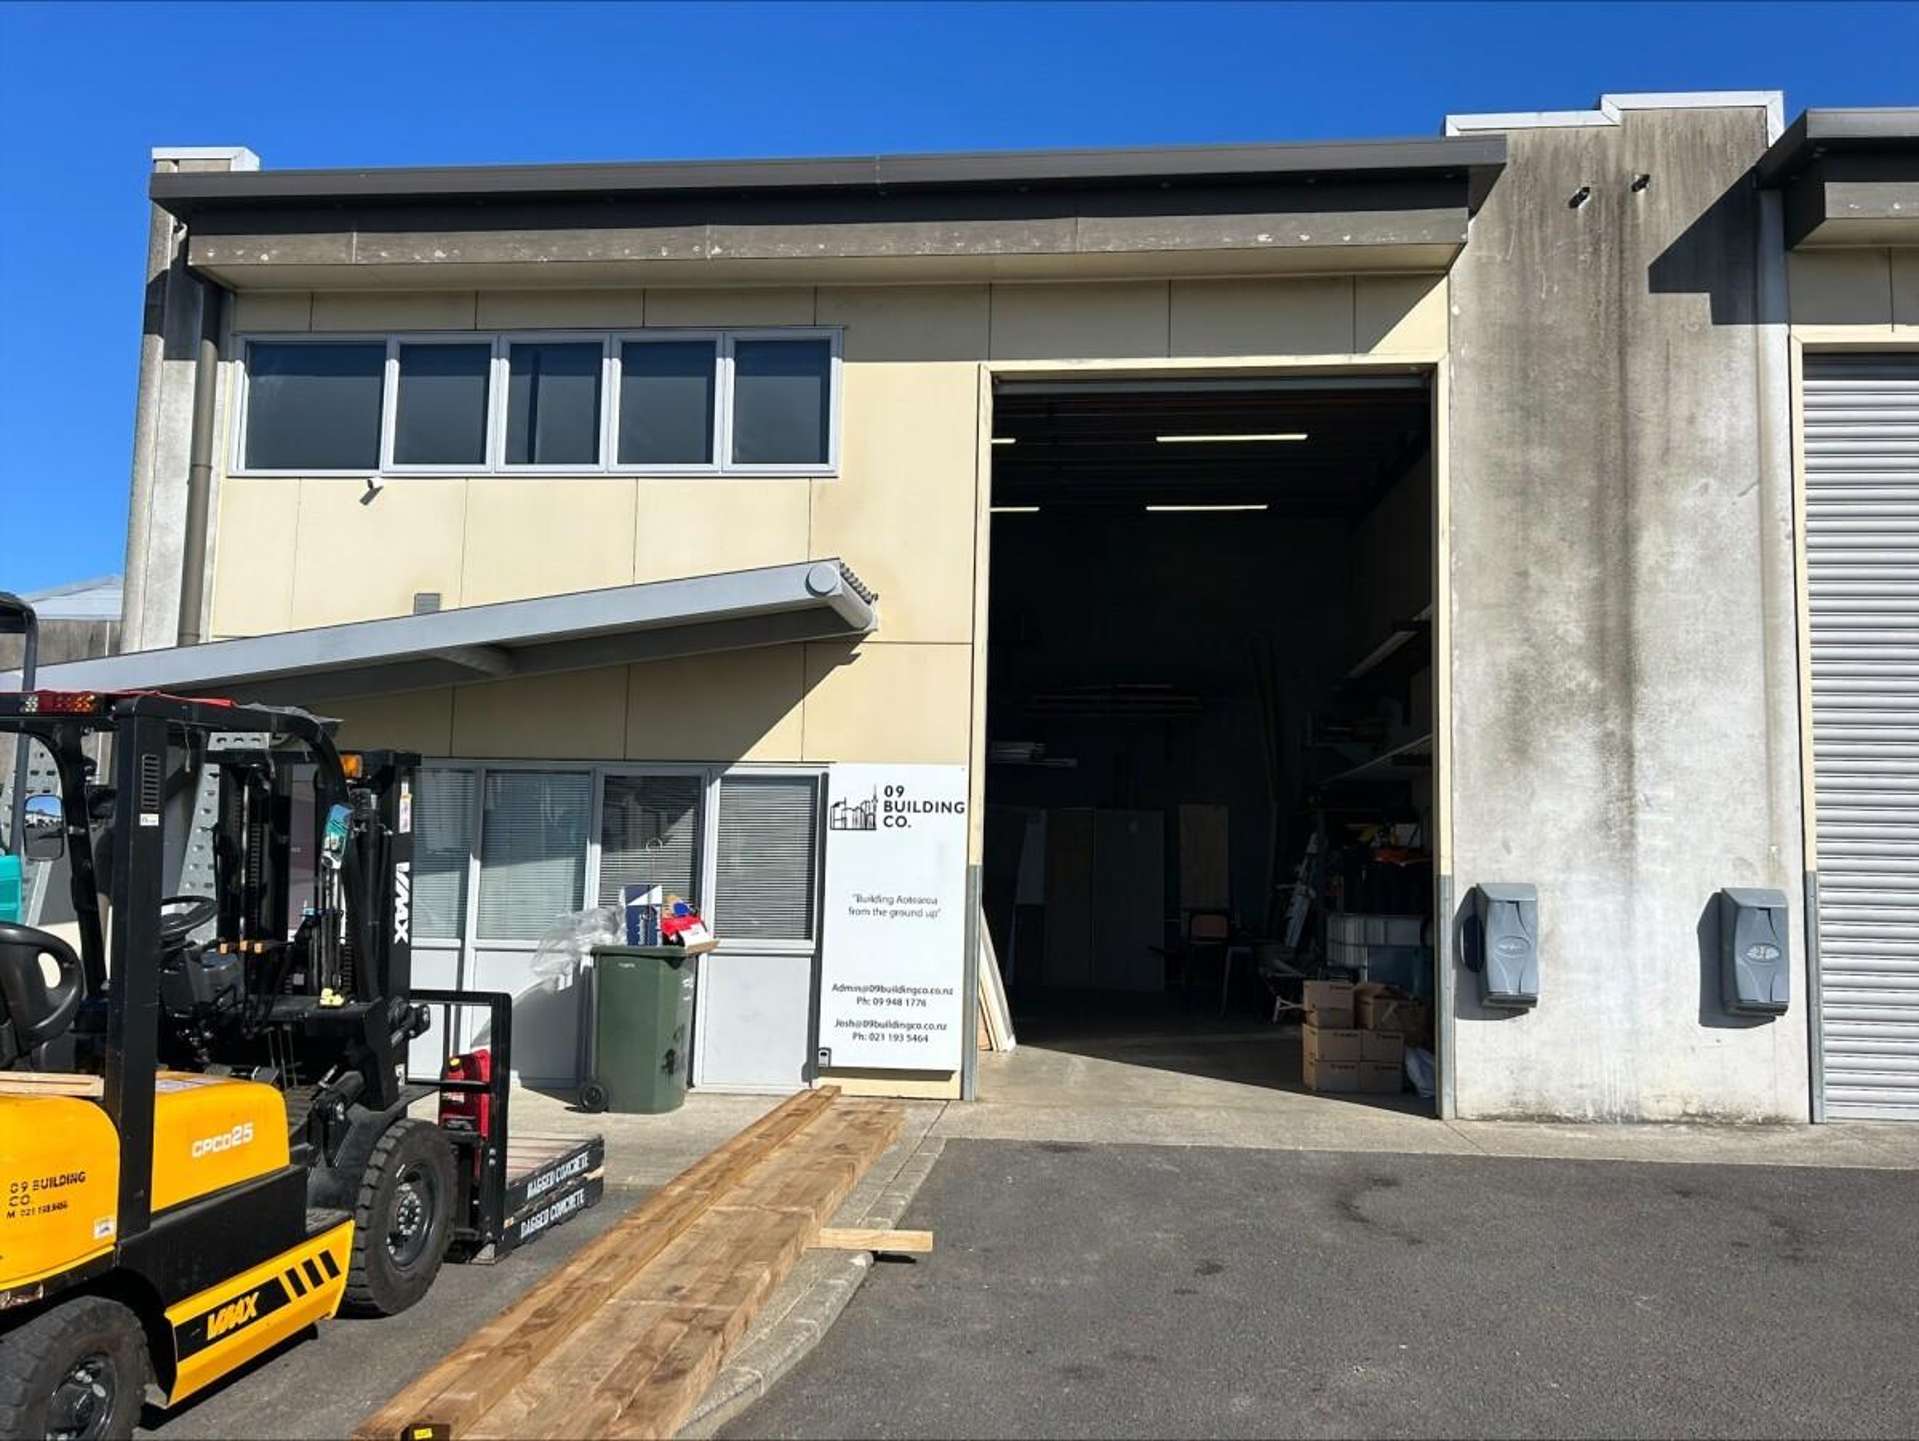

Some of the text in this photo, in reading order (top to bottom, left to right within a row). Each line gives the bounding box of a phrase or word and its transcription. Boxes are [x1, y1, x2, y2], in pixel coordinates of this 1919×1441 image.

[883, 785, 905, 798] 09
[883, 800, 966, 814] BUILDING
[883, 815, 912, 828] CO.
[394, 862, 410, 944] VMAX
[896, 895, 938, 905] Aotearoa
[848, 907, 871, 915] from
[872, 907, 888, 917] the
[889, 908, 923, 919] ground
[831, 983, 954, 996] Admin@09buildingco.co.nz
[856, 996, 870, 1005] Ph:
[872, 997, 884, 1006] 09
[886, 997, 903, 1007] 948
[834, 1018, 948, 1031] Josh@09buildingco.co.nz
[852, 1031, 929, 1043] Ph: 021 193 5464
[555, 1151, 589, 1182] CONCRETE
[10, 1171, 86, 1194] 09 BUILDING
[549, 1188, 585, 1220] CONCRETE
[207, 1291, 260, 1340] VMAX
